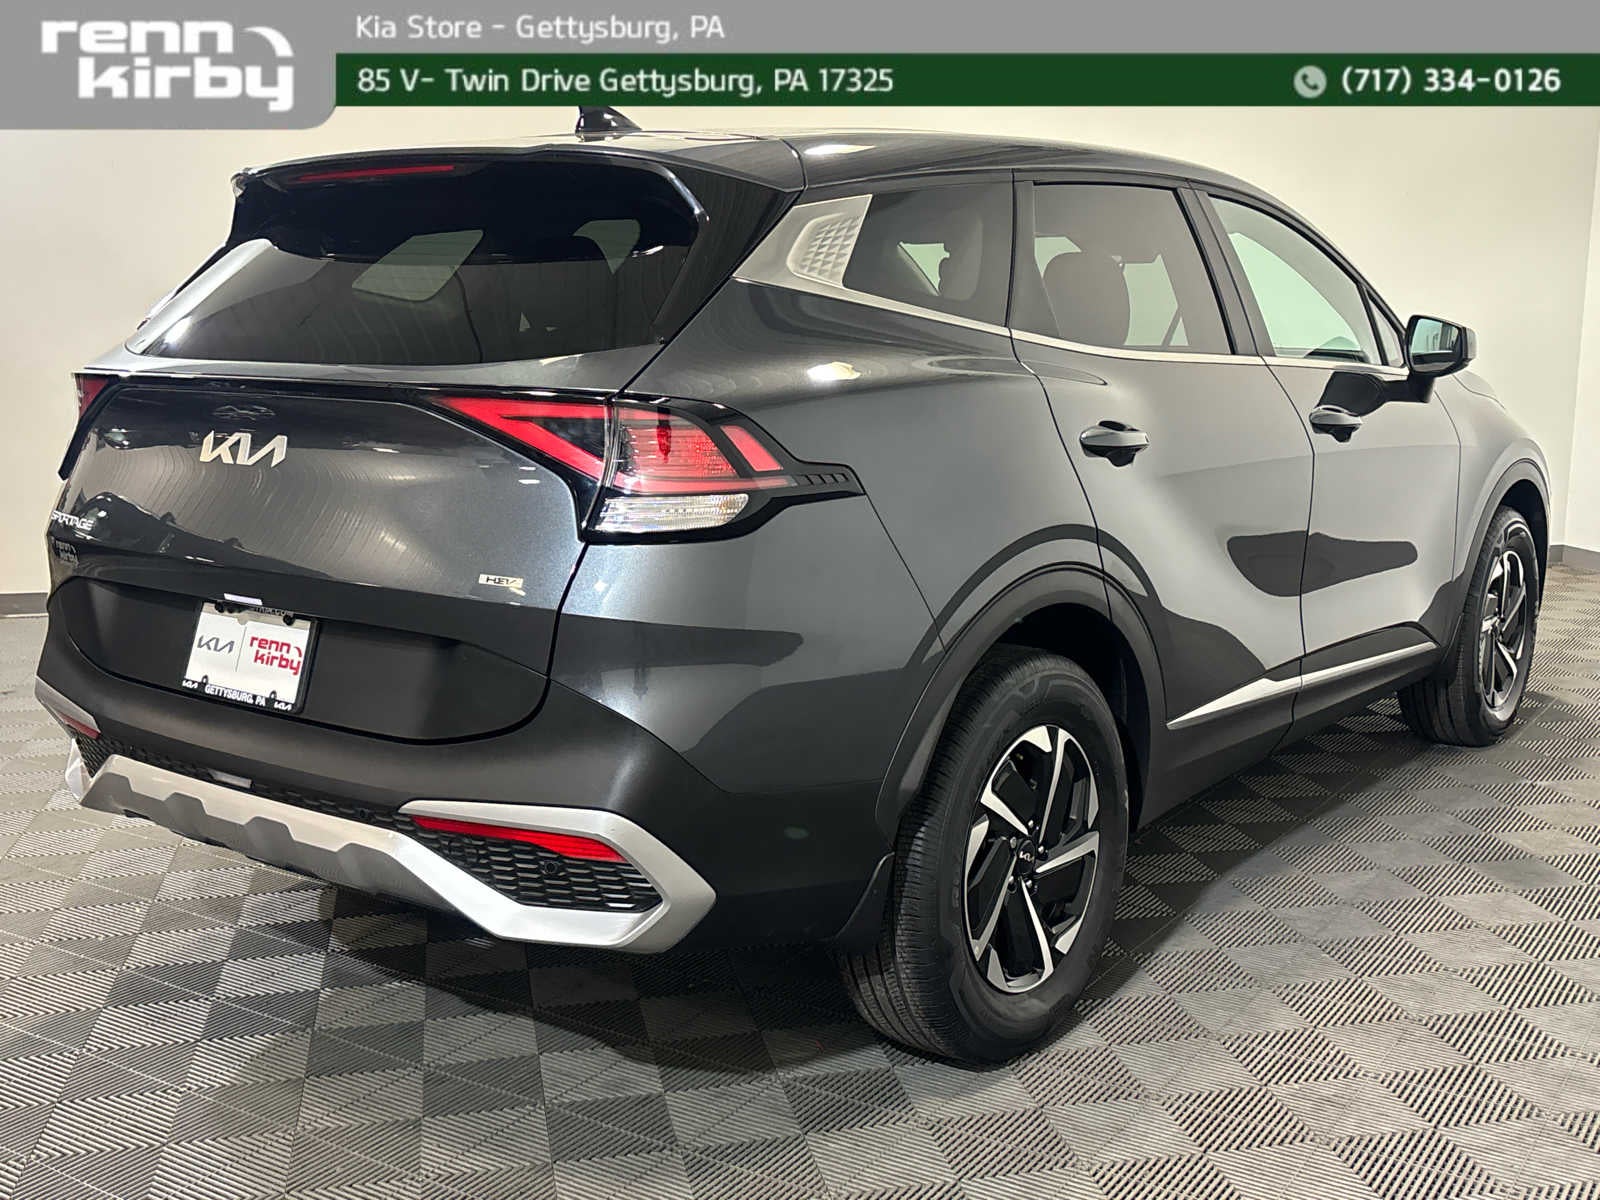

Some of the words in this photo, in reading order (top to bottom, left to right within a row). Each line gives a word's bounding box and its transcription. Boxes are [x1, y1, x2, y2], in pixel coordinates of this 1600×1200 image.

[199, 430, 288, 469] KIA
[197, 635, 235, 654] KIA
[249, 636, 291, 654] renn
[253, 650, 301, 676] kirby
[255, 696, 266, 706] PA
